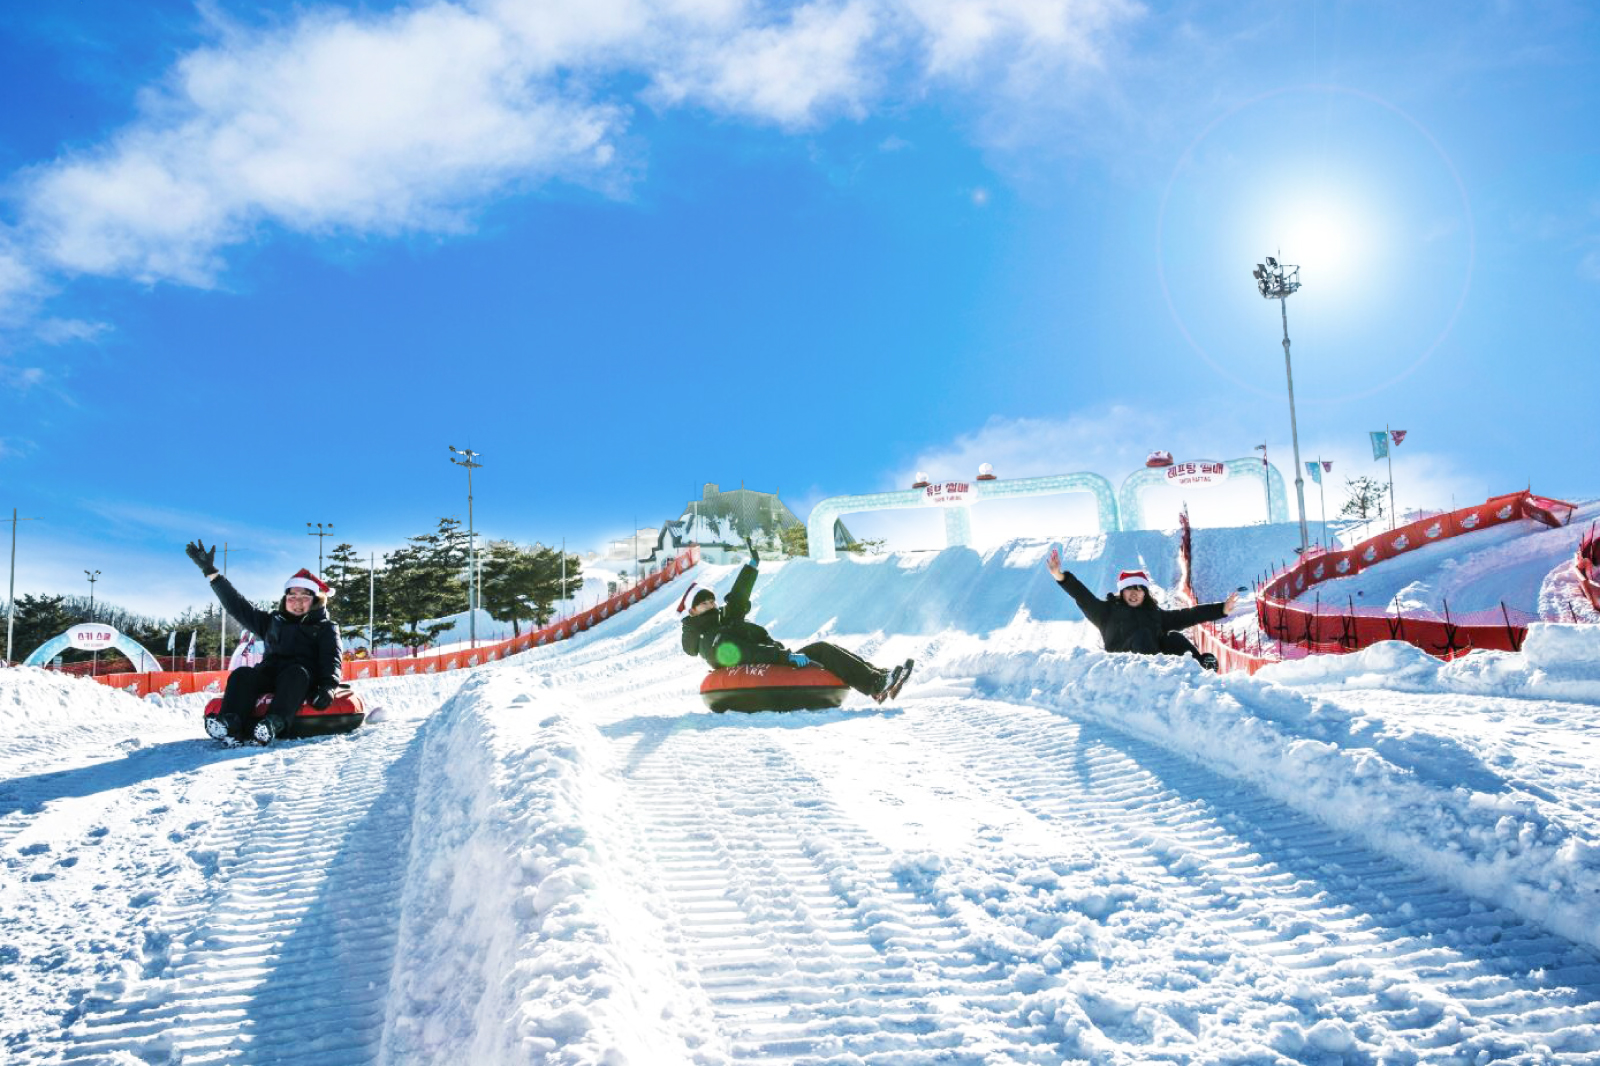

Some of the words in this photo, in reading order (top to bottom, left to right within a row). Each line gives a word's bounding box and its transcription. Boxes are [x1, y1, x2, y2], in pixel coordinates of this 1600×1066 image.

[927, 484, 941, 496] 튜브
[946, 483, 969, 493] 썰매
[78, 632, 92, 640] 스키
